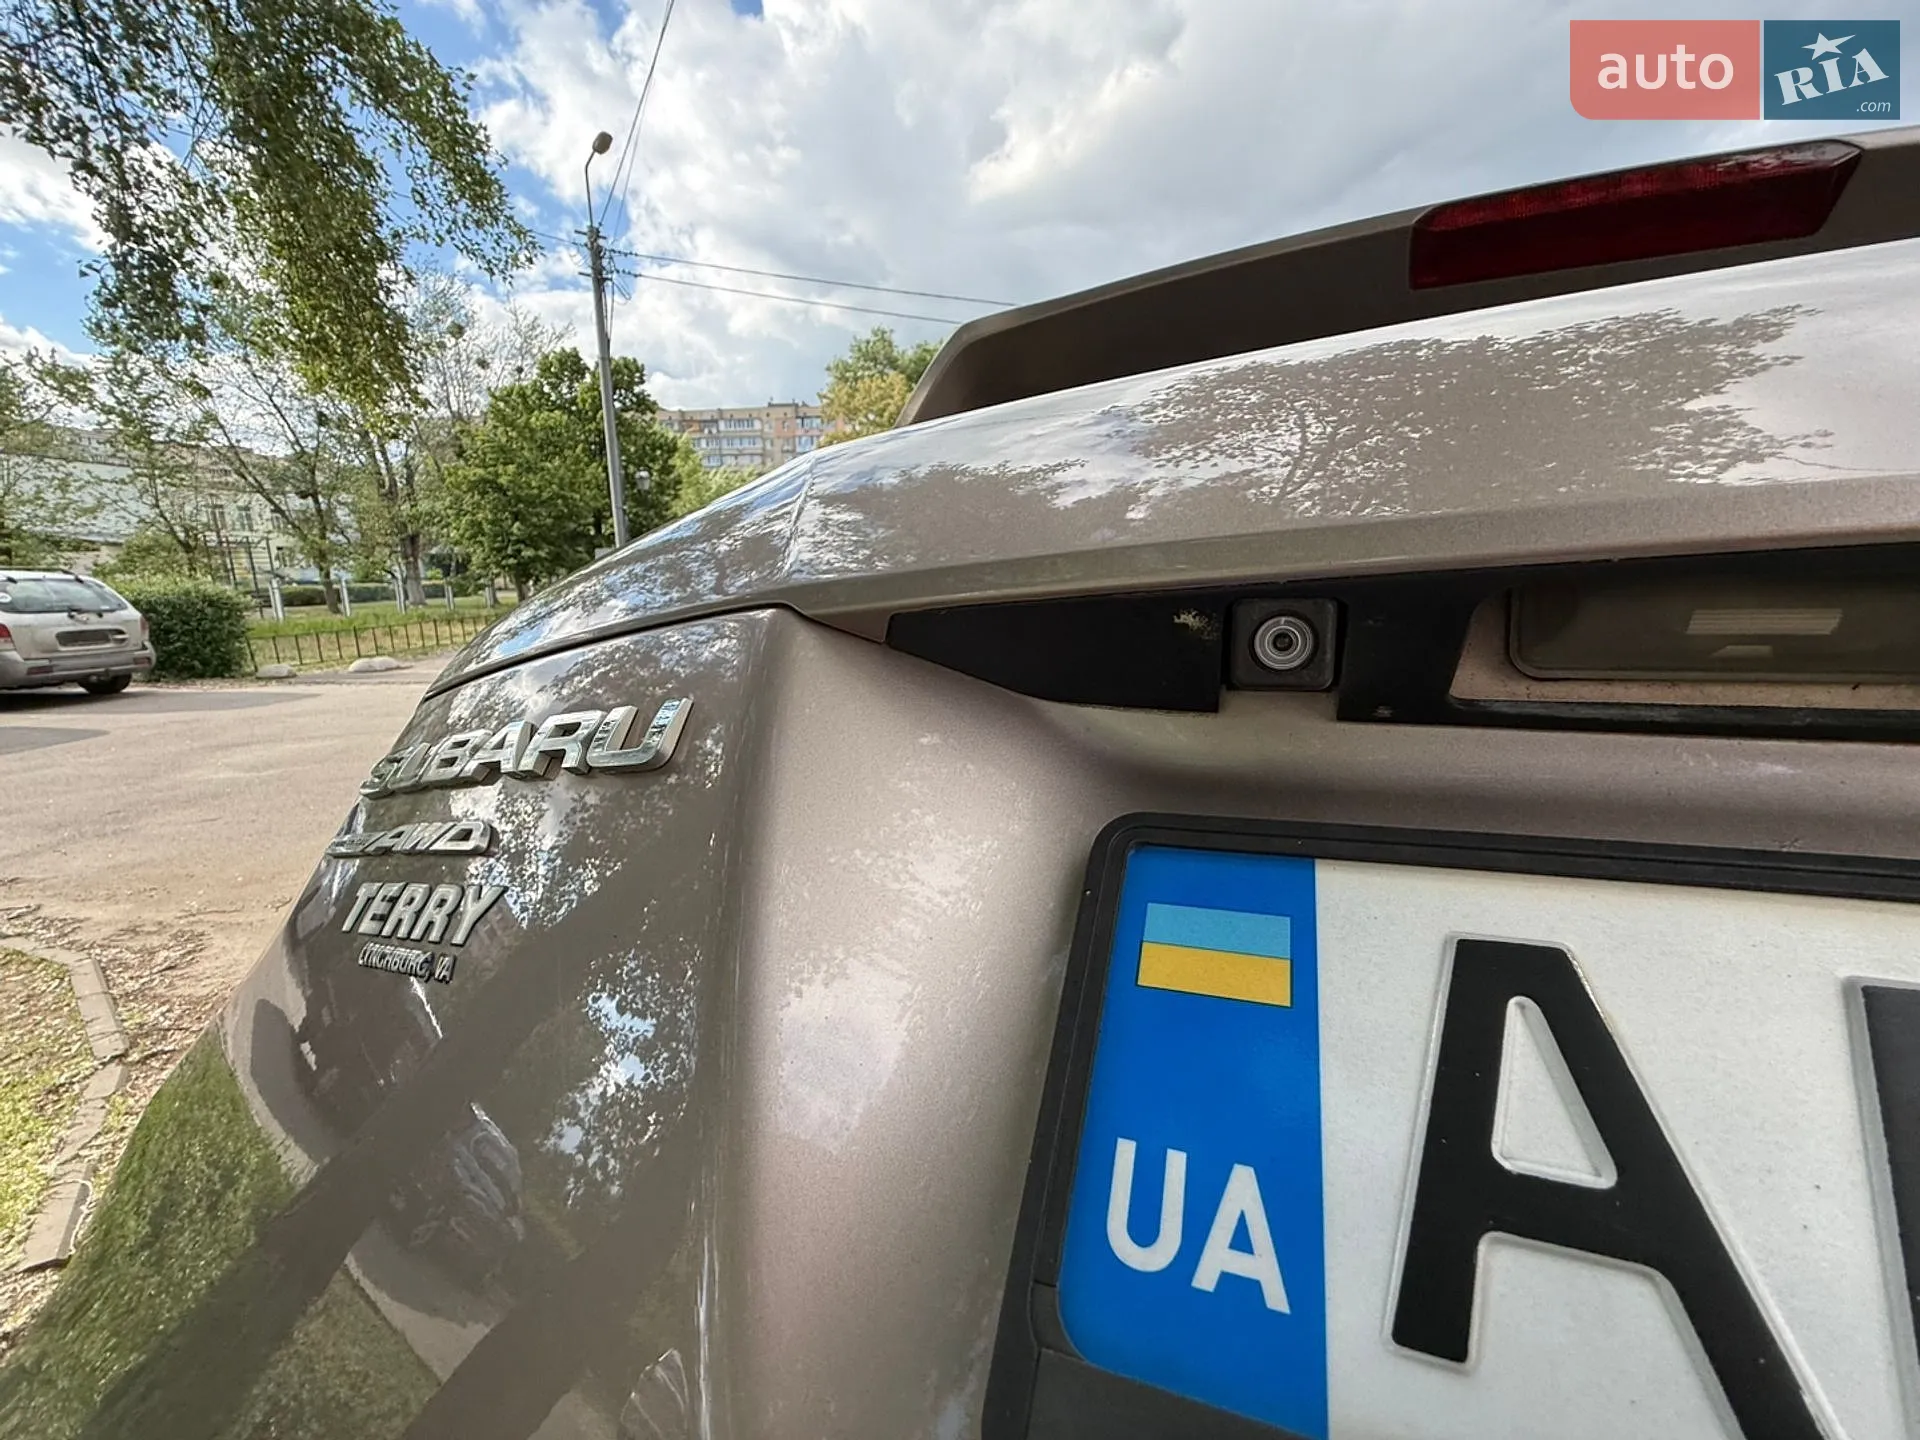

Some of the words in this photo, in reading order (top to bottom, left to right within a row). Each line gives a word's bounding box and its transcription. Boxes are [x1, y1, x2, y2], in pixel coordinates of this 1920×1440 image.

[359, 697, 695, 799] SUBARU
[367, 820, 493, 855] AWD
[341, 881, 509, 946] TERRY
[434, 953, 457, 984] VA
[1106, 1137, 1292, 1316] UA
